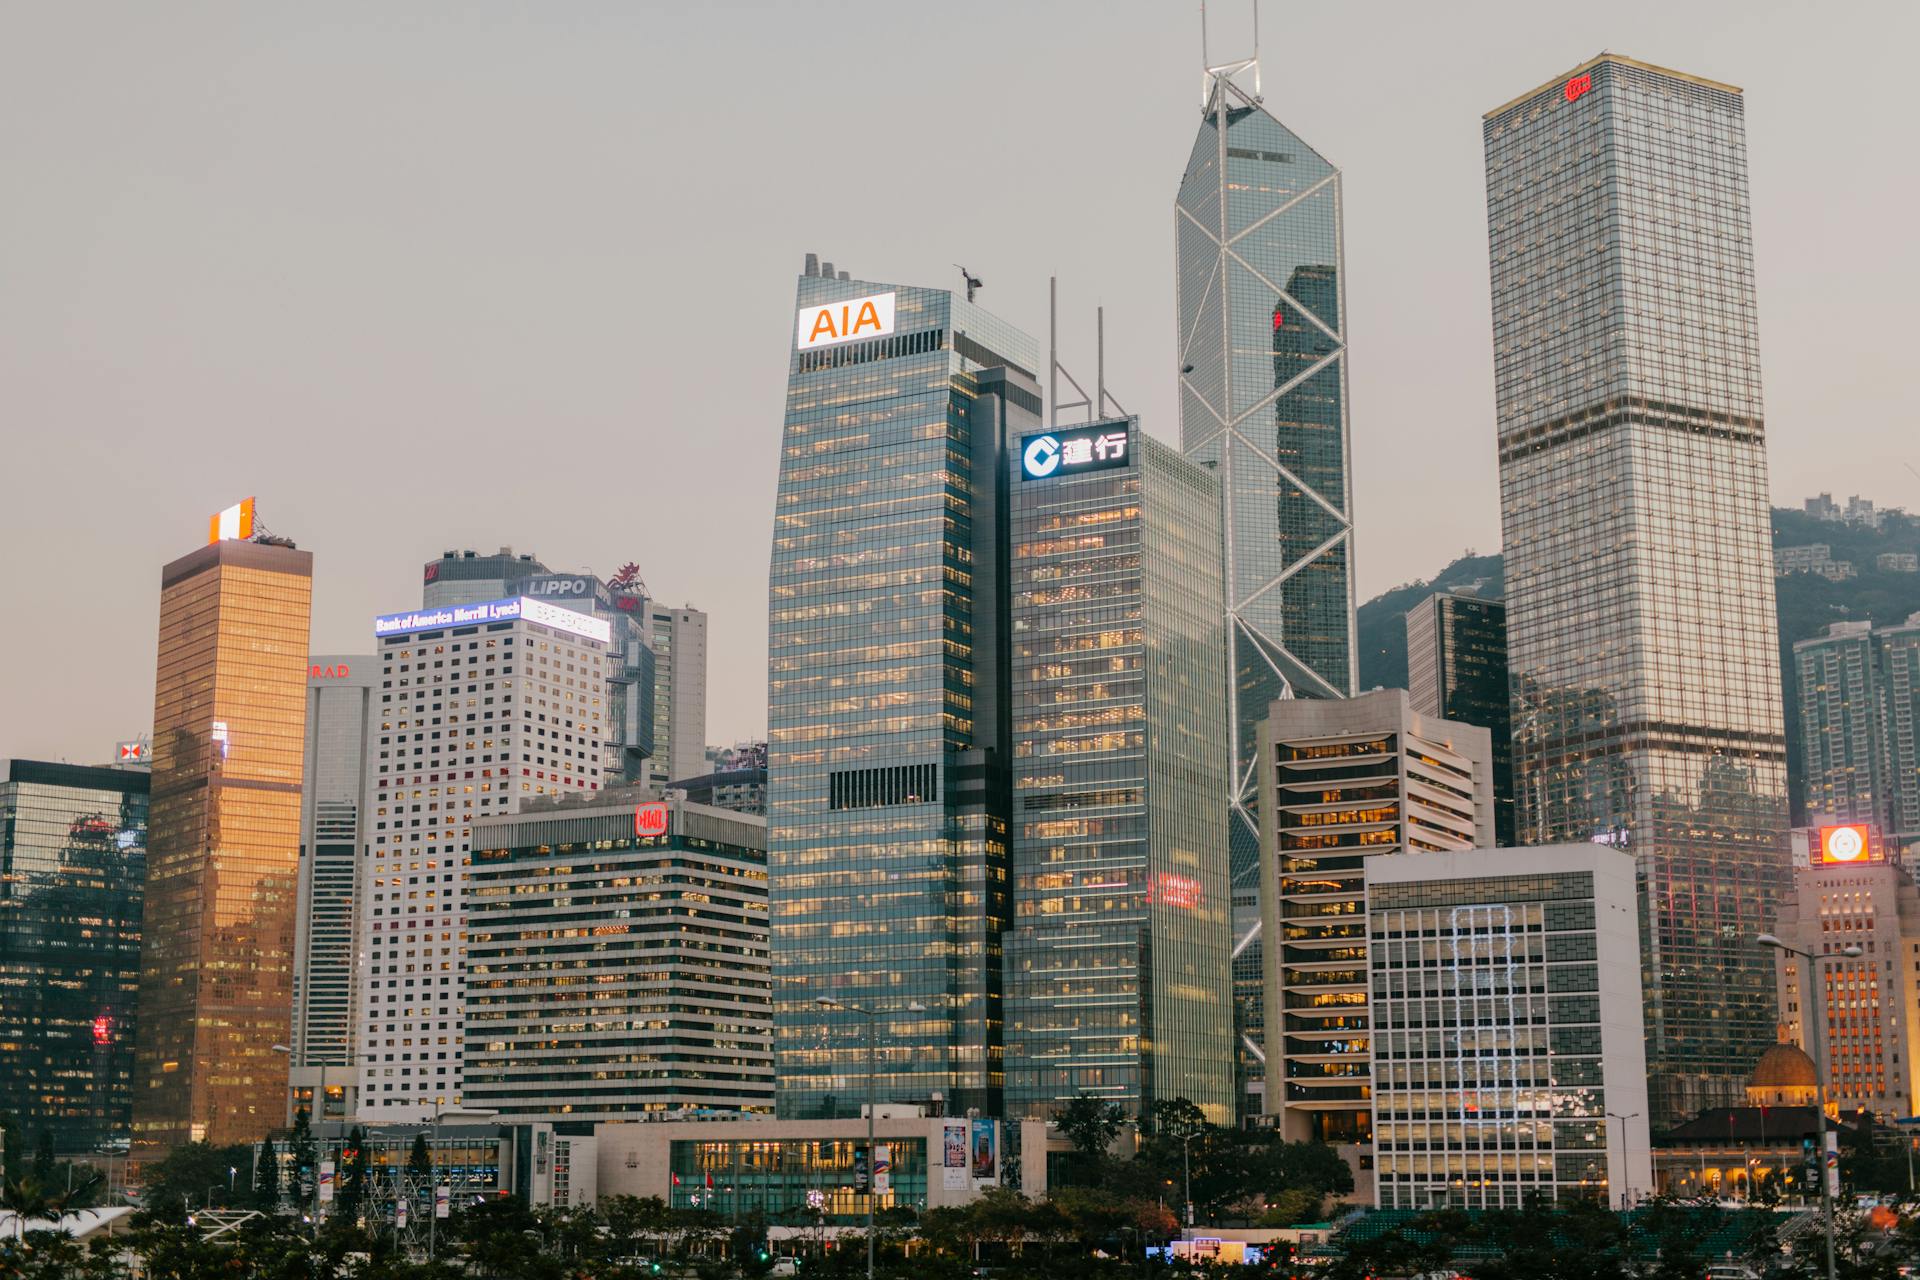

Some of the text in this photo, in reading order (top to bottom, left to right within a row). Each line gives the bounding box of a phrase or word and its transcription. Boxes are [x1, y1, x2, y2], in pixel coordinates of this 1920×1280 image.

[809, 301, 881, 342] AIA
[1062, 432, 1127, 465] 建行
[529, 580, 586, 594] LIPPO
[376, 601, 520, 632] Bank of America Merrill Lynch
[307, 664, 350, 679] RAD
